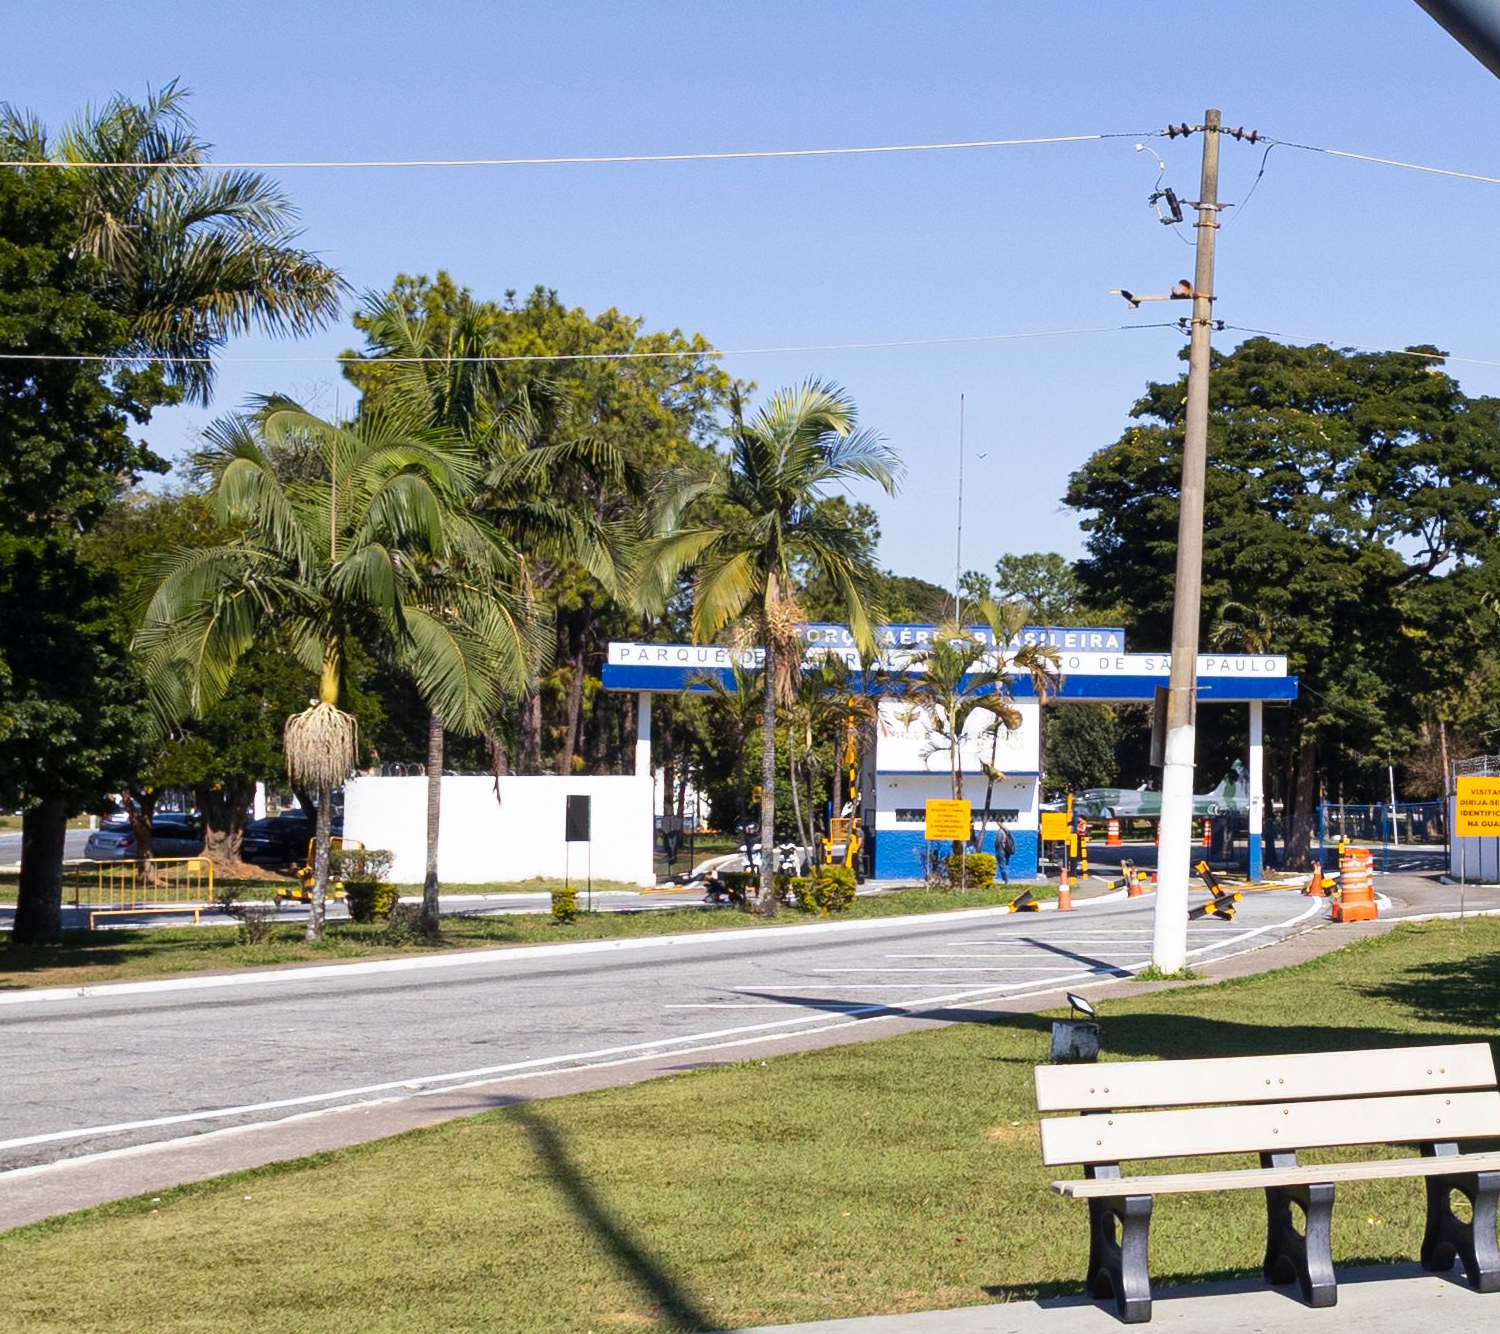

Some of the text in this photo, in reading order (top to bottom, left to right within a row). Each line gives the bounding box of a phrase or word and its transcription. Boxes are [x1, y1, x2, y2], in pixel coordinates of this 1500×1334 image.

[620, 648, 725, 663] PARQUE
[1100, 657, 1125, 670] DE
[1206, 658, 1276, 672] PAULO
